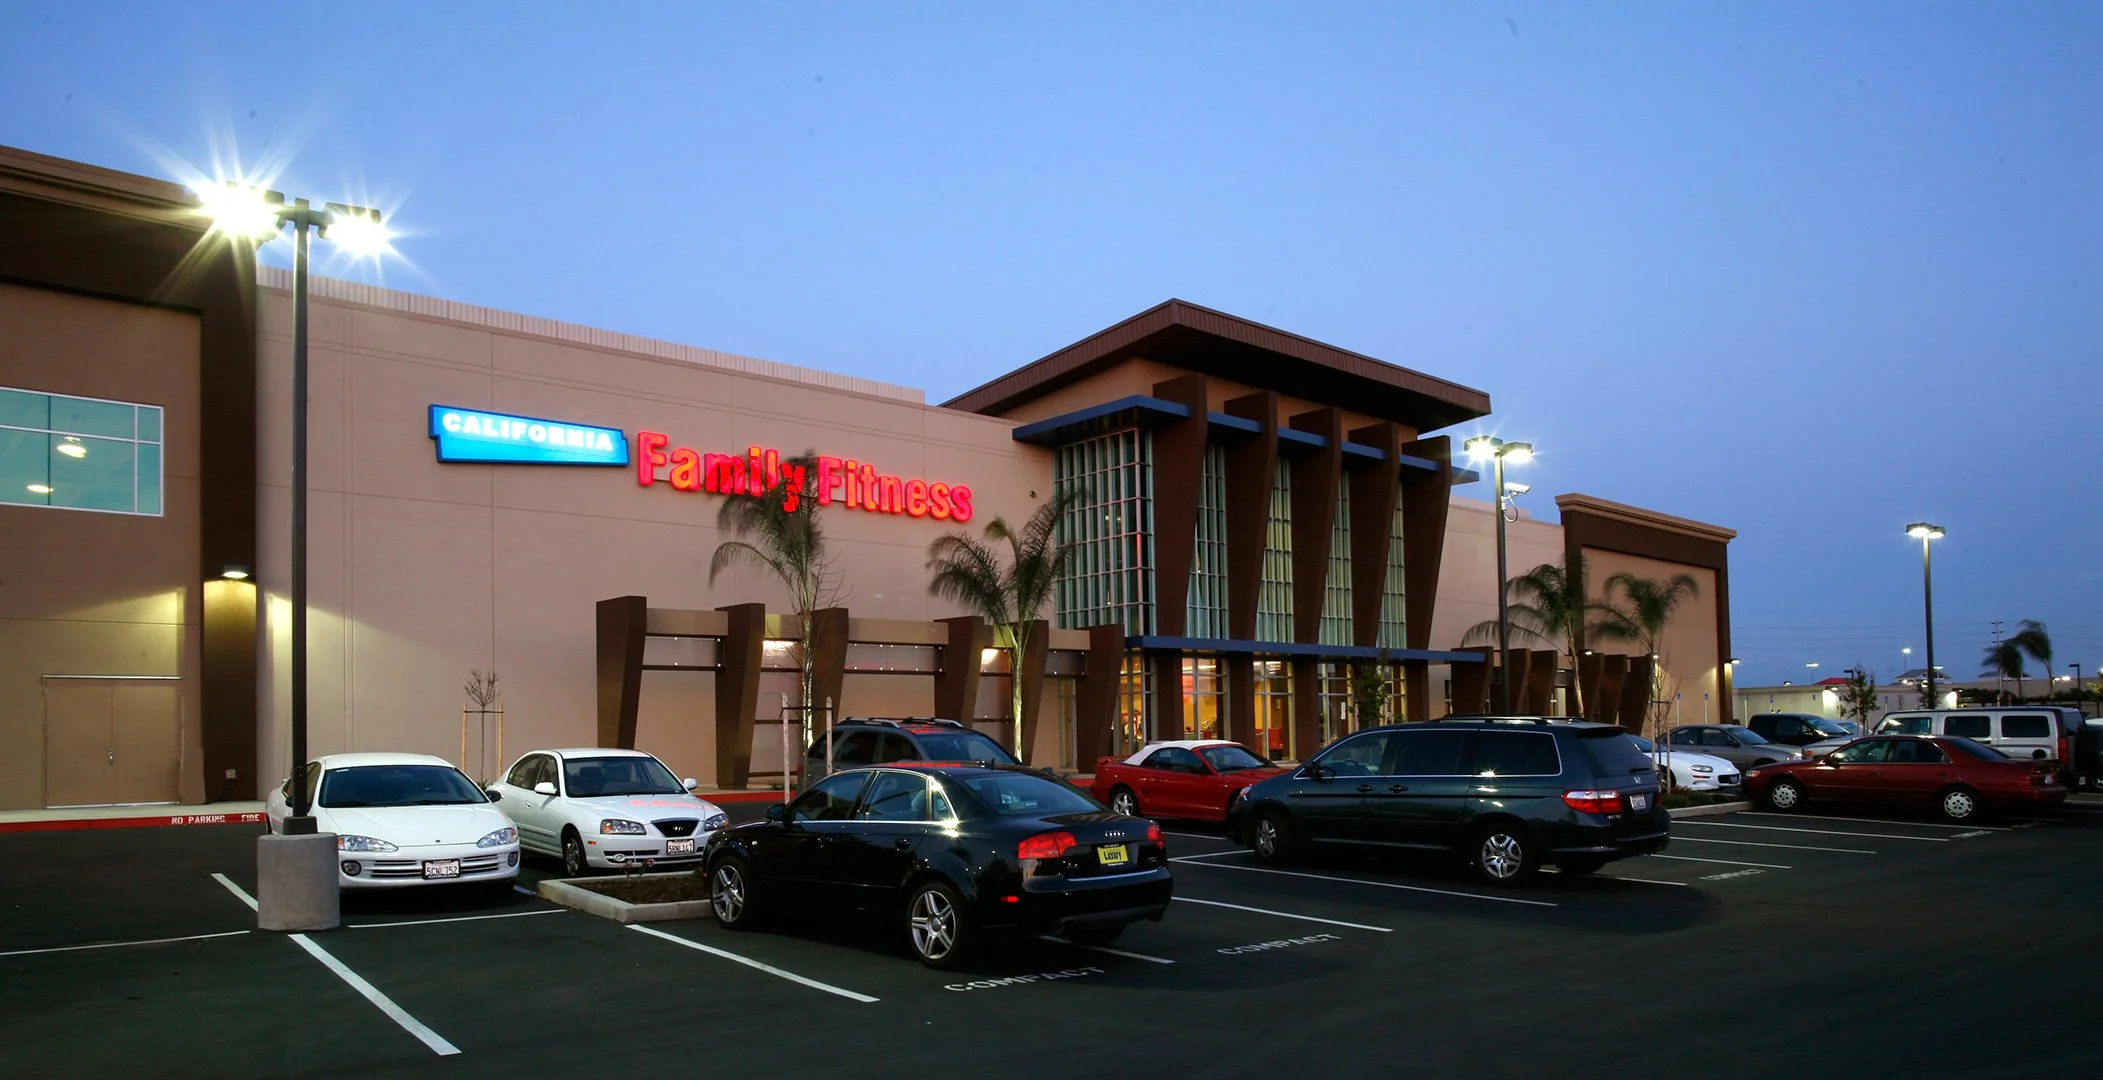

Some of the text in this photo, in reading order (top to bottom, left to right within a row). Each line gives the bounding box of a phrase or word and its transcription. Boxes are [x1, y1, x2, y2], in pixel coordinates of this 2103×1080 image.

[443, 413, 613, 451] CALIFORNIA
[638, 432, 973, 523] Family Fitness
[171, 813, 260, 825] NO PARKING FIRE
[1217, 933, 1341, 955] COMPACT
[944, 966, 1105, 991] COMPACT
